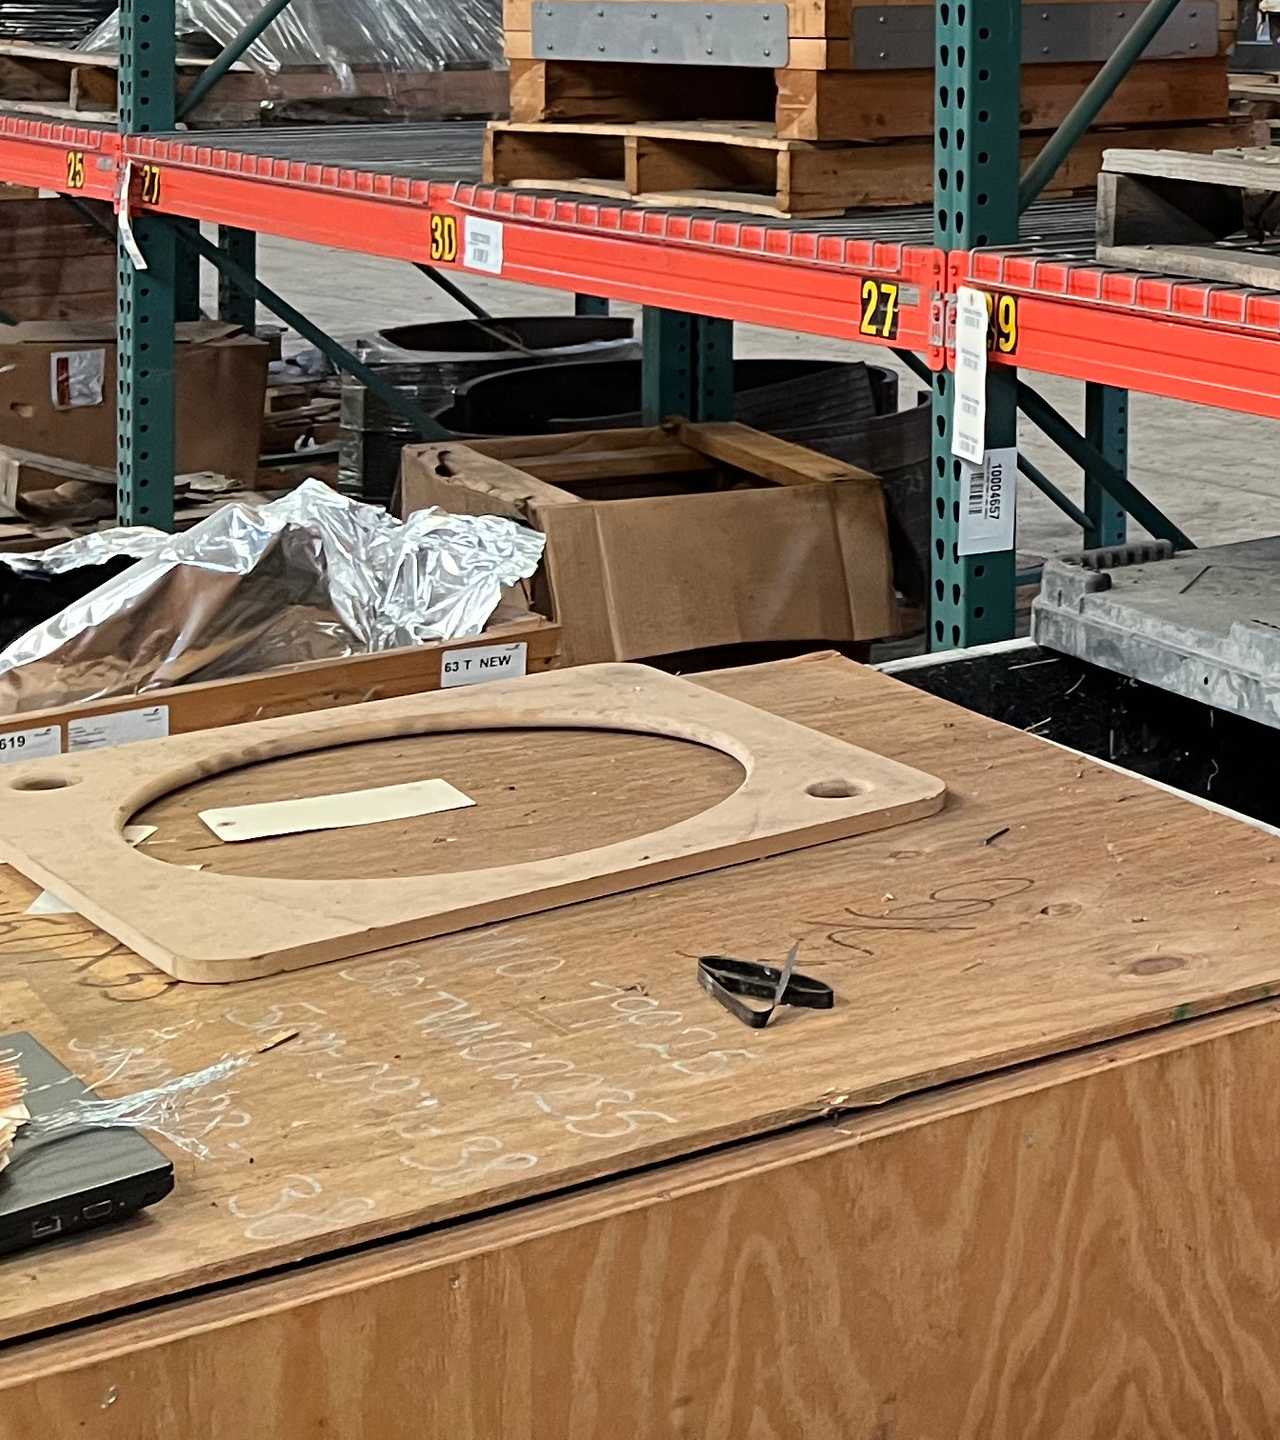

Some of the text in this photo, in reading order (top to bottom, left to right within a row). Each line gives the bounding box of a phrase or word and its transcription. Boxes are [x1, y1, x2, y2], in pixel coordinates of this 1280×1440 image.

[67, 151, 85, 188] 25
[142, 165, 161, 204] 27
[431, 215, 456, 261] 3D
[861, 280, 898, 338] 27
[988, 463, 1003, 520] 10004657
[444, 654, 512, 673] 63 T NEW
